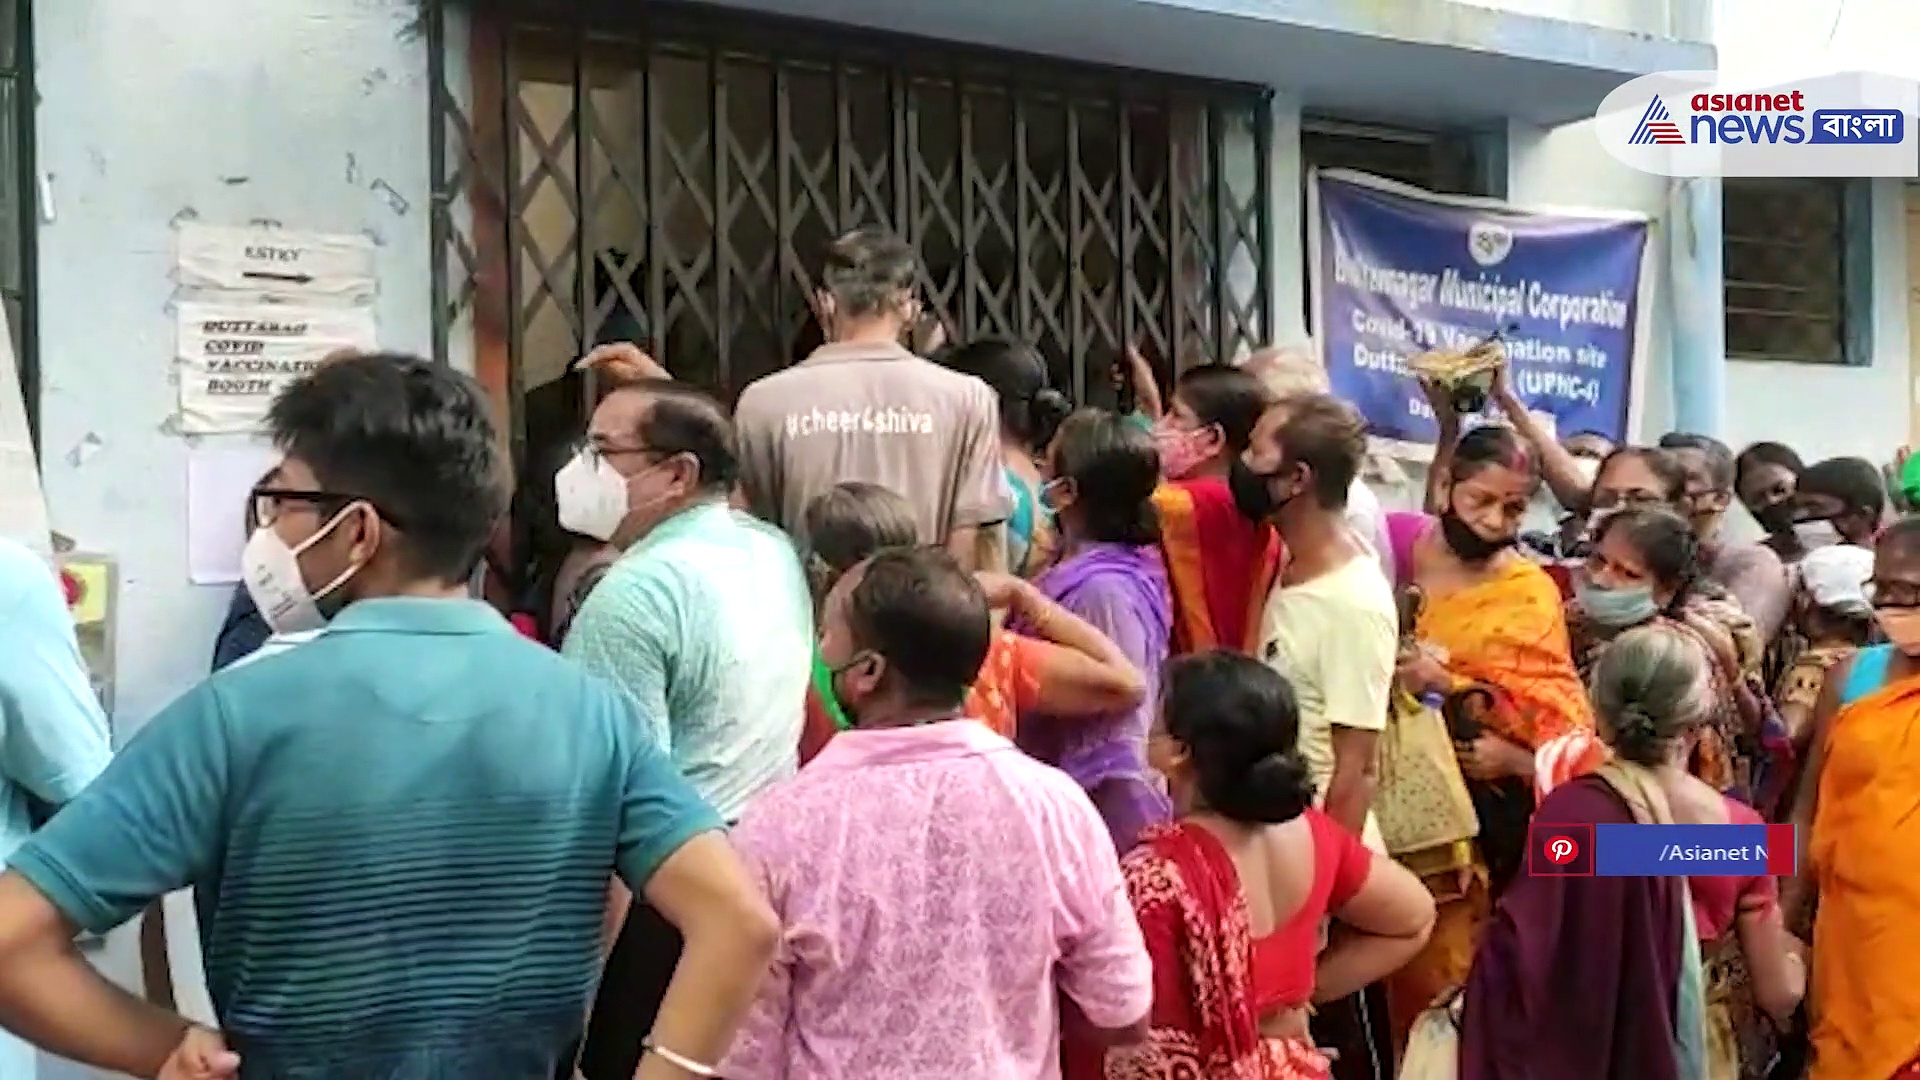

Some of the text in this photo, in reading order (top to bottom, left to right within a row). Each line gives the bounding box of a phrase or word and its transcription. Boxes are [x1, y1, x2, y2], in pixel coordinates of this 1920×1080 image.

[1440, 267, 1525, 323] Municipal
[204, 340, 264, 355] COVID
[1577, 343, 1607, 368] site
[207, 380, 272, 395] BOOTH
